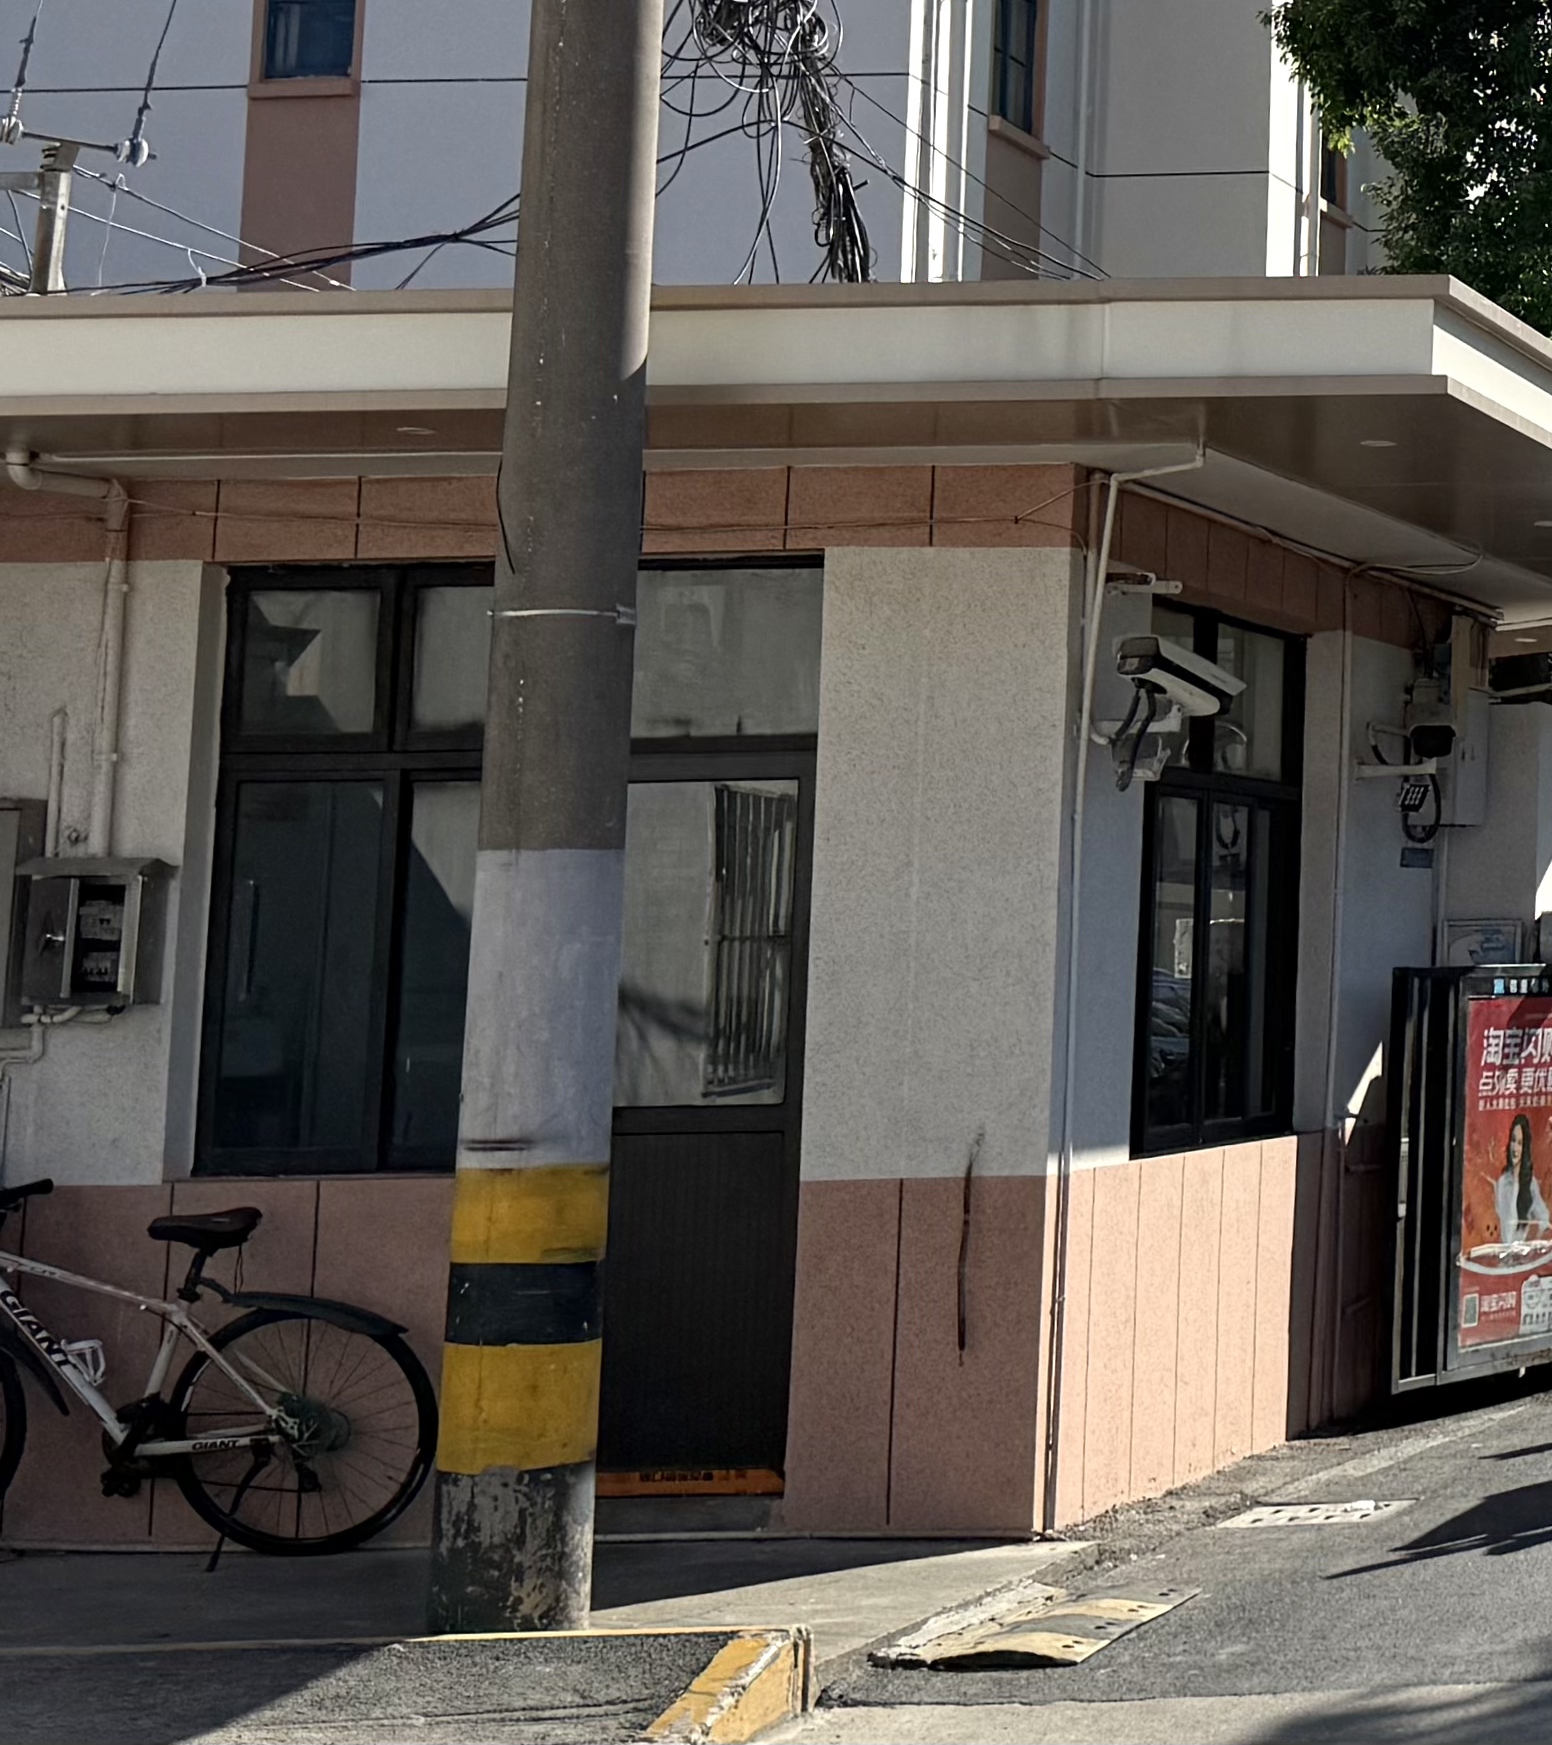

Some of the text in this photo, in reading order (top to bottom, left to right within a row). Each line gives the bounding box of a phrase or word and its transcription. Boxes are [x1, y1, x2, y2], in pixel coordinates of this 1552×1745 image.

[1478, 1068, 1518, 1097] 点外卖
[192, 1440, 240, 1451] GIANT
